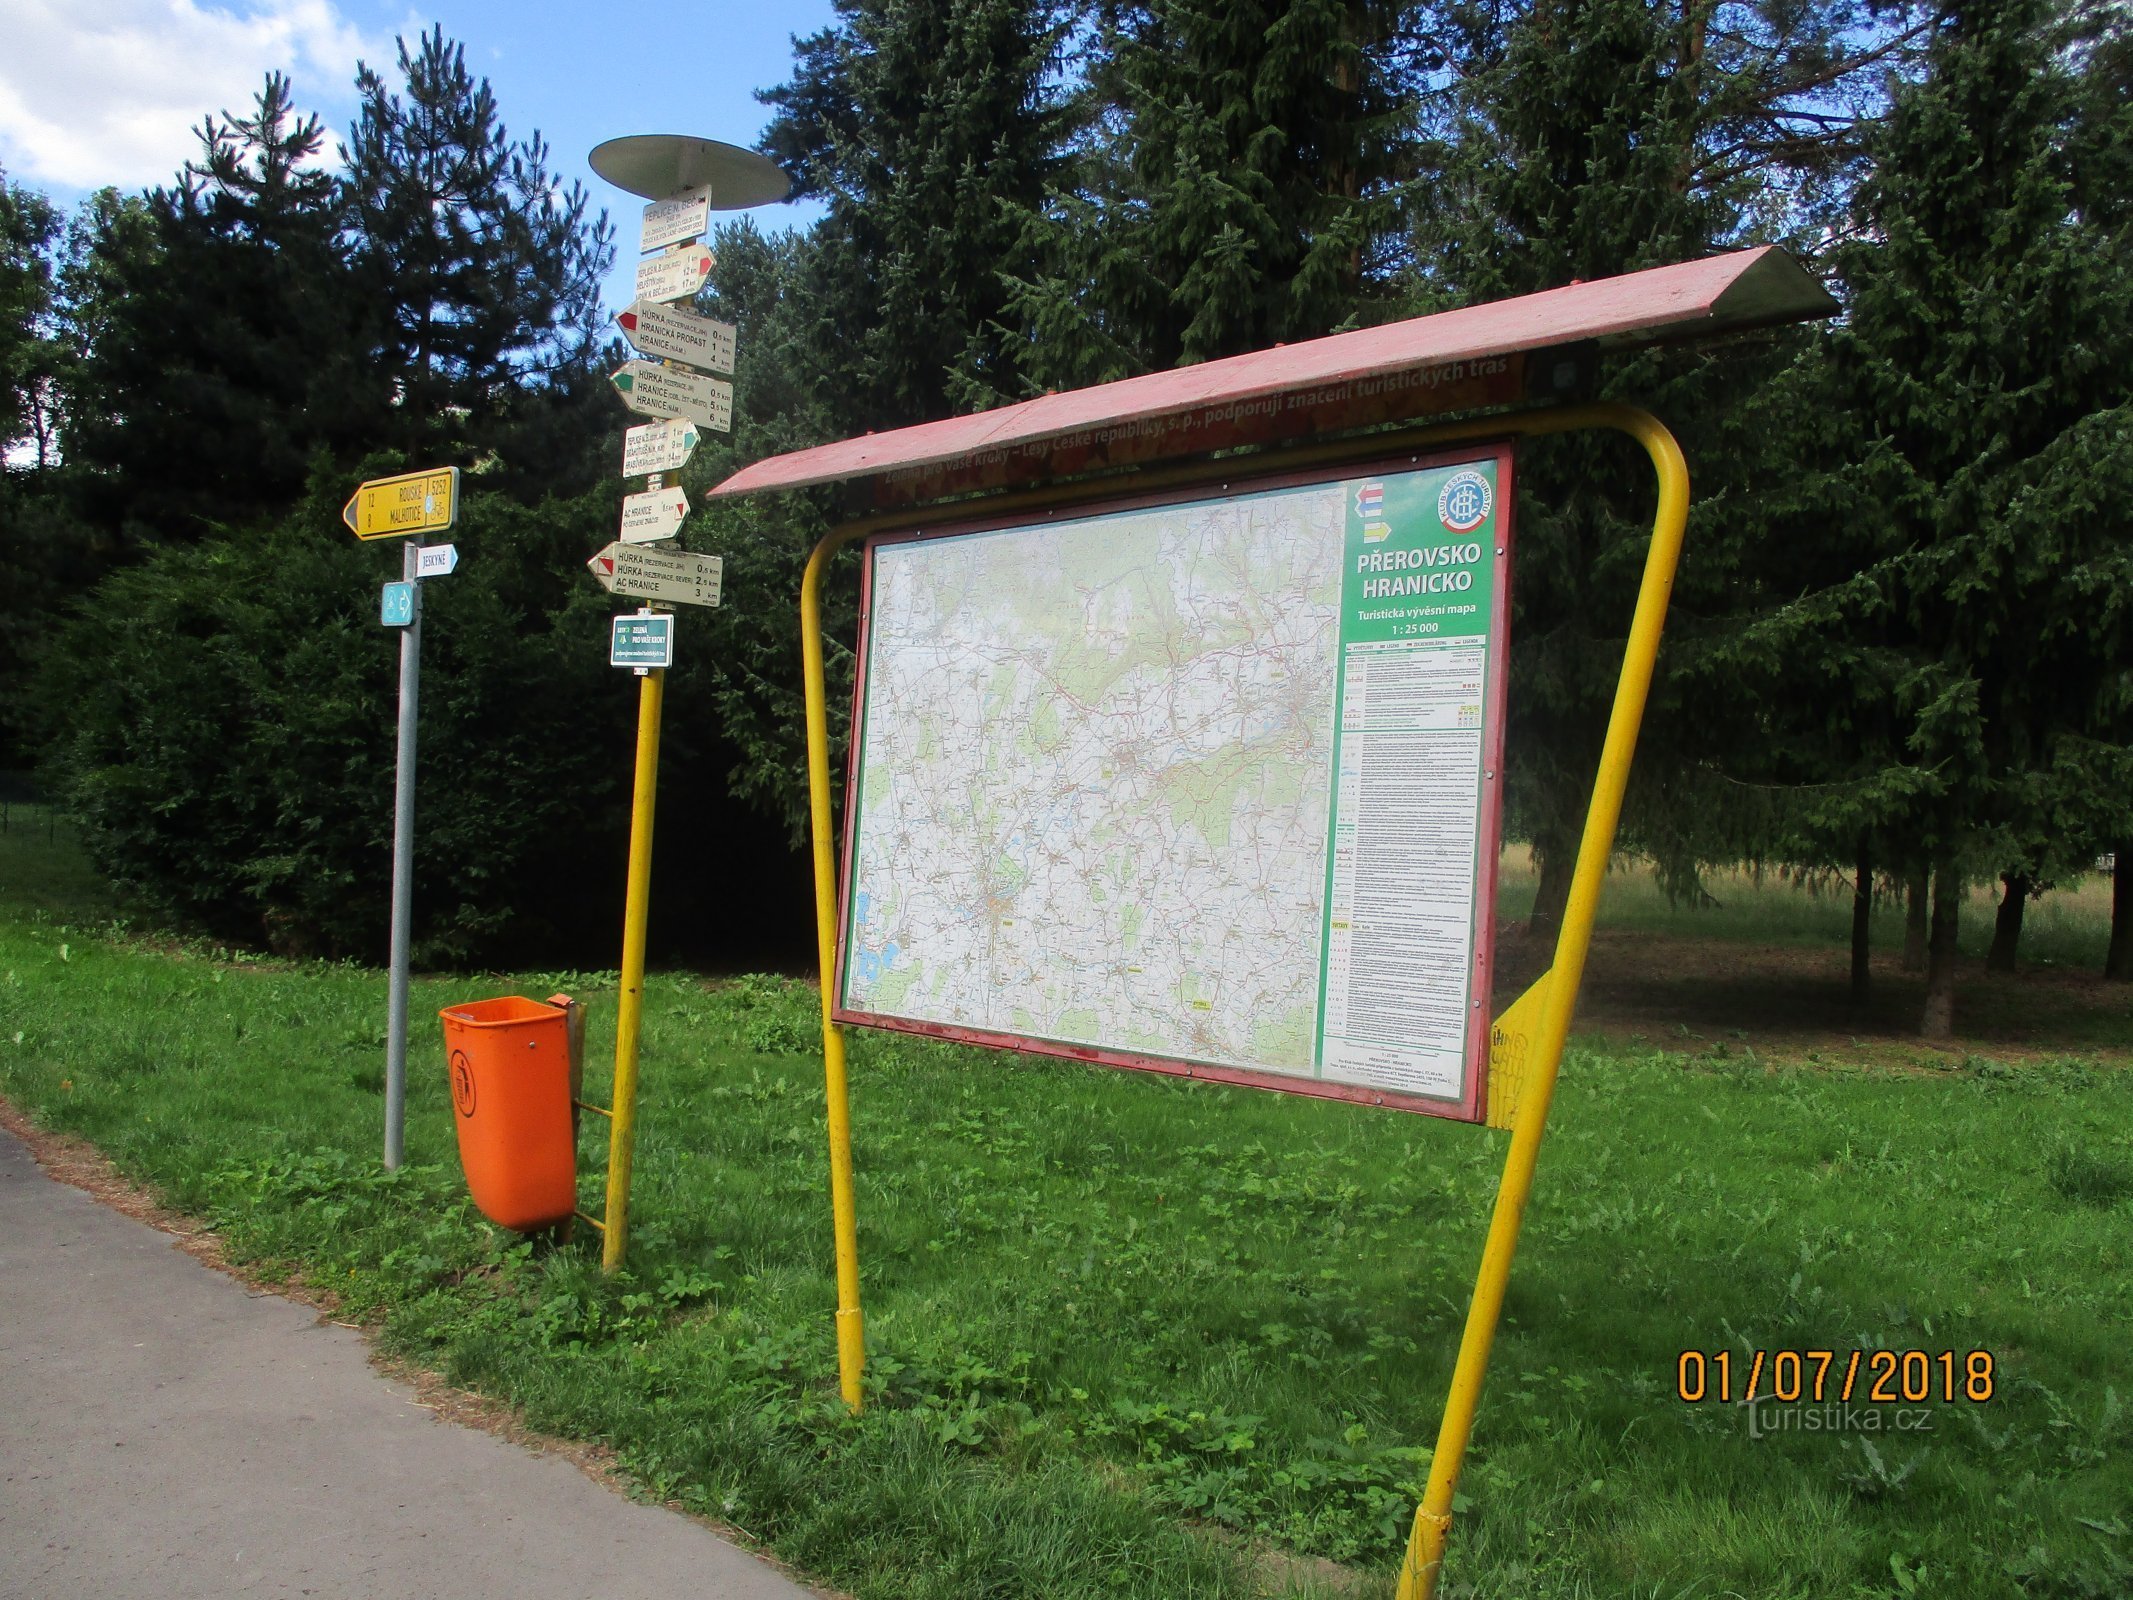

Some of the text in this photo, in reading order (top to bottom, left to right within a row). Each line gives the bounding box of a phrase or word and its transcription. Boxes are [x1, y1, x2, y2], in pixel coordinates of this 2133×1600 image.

[642, 309, 665, 324] HŮRKA
[640, 333, 670, 350] HRANICE
[676, 331, 706, 348] PROPAST
[712, 343, 716, 351] 1
[711, 354, 716, 363] 4
[638, 369, 663, 384] HŮRKA
[637, 382, 668, 398] HRANICE
[636, 394, 667, 411] HRANICE
[1023, 440, 1049, 459] Lesy
[1205, 393, 1283, 428] podporují
[1357, 362, 1464, 397] turistických
[1470, 357, 1507, 377] tras
[709, 413, 715, 422] 6
[368, 493, 375, 508] 12
[618, 551, 644, 565] HŮRKA
[1357, 543, 1482, 574] PŘEROVSKO
[617, 563, 643, 577] HŮRKA
[709, 568, 720, 576] km
[616, 577, 627, 588] AC
[628, 579, 660, 592] HRANICE
[708, 580, 719, 588] km
[1363, 570, 1473, 599] HRANICKO
[695, 588, 701, 597] 3
[1358, 604, 1476, 621] Turistická vývěsní mapa
[1392, 625, 1397, 635] 1
[1405, 624, 1418, 634] 25
[1419, 622, 1439, 633] 000
